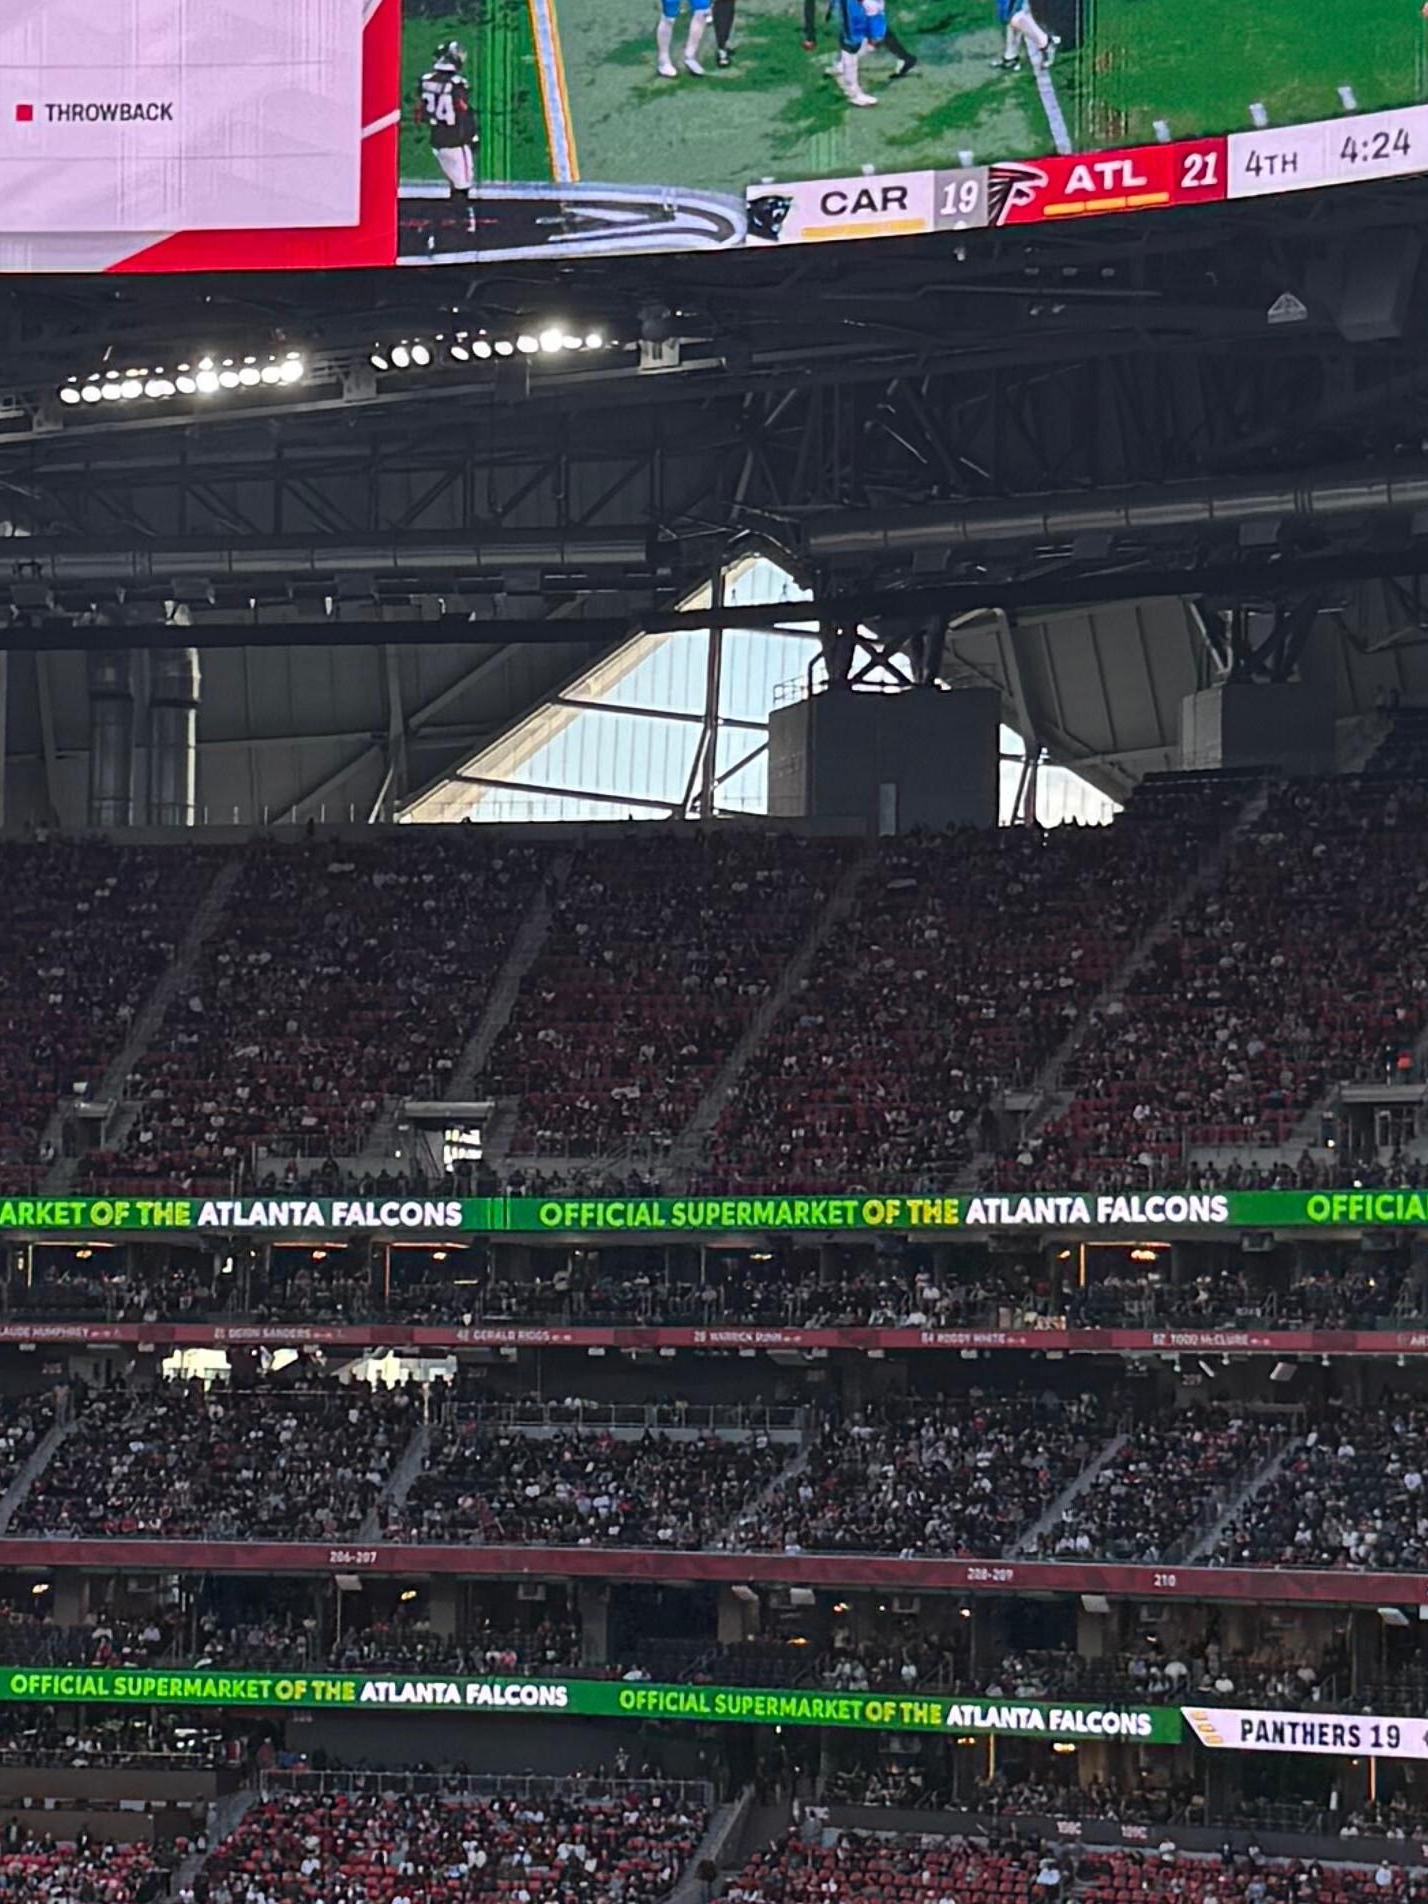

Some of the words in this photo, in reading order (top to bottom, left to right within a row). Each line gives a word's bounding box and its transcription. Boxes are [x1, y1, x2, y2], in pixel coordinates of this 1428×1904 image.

[44, 100, 174, 123] THROWBACK
[820, 187, 908, 218] CAR
[939, 182, 976, 215] 19
[1064, 162, 1147, 195] ATL
[1181, 153, 1218, 188] 21
[1245, 148, 1299, 178] 4TH
[1339, 131, 1411, 166] 4:24
[540, 1202, 664, 1227] OFFICIAL
[673, 1200, 855, 1227] SUPERMARKET
[862, 1200, 901, 1224] OF
[907, 1200, 959, 1224] THE
[966, 1197, 1090, 1222] ATLANTA
[1097, 1196, 1228, 1222] FALCONS
[1240, 1719, 1359, 1748] PANTHERS
[1370, 1725, 1400, 1748] 19
